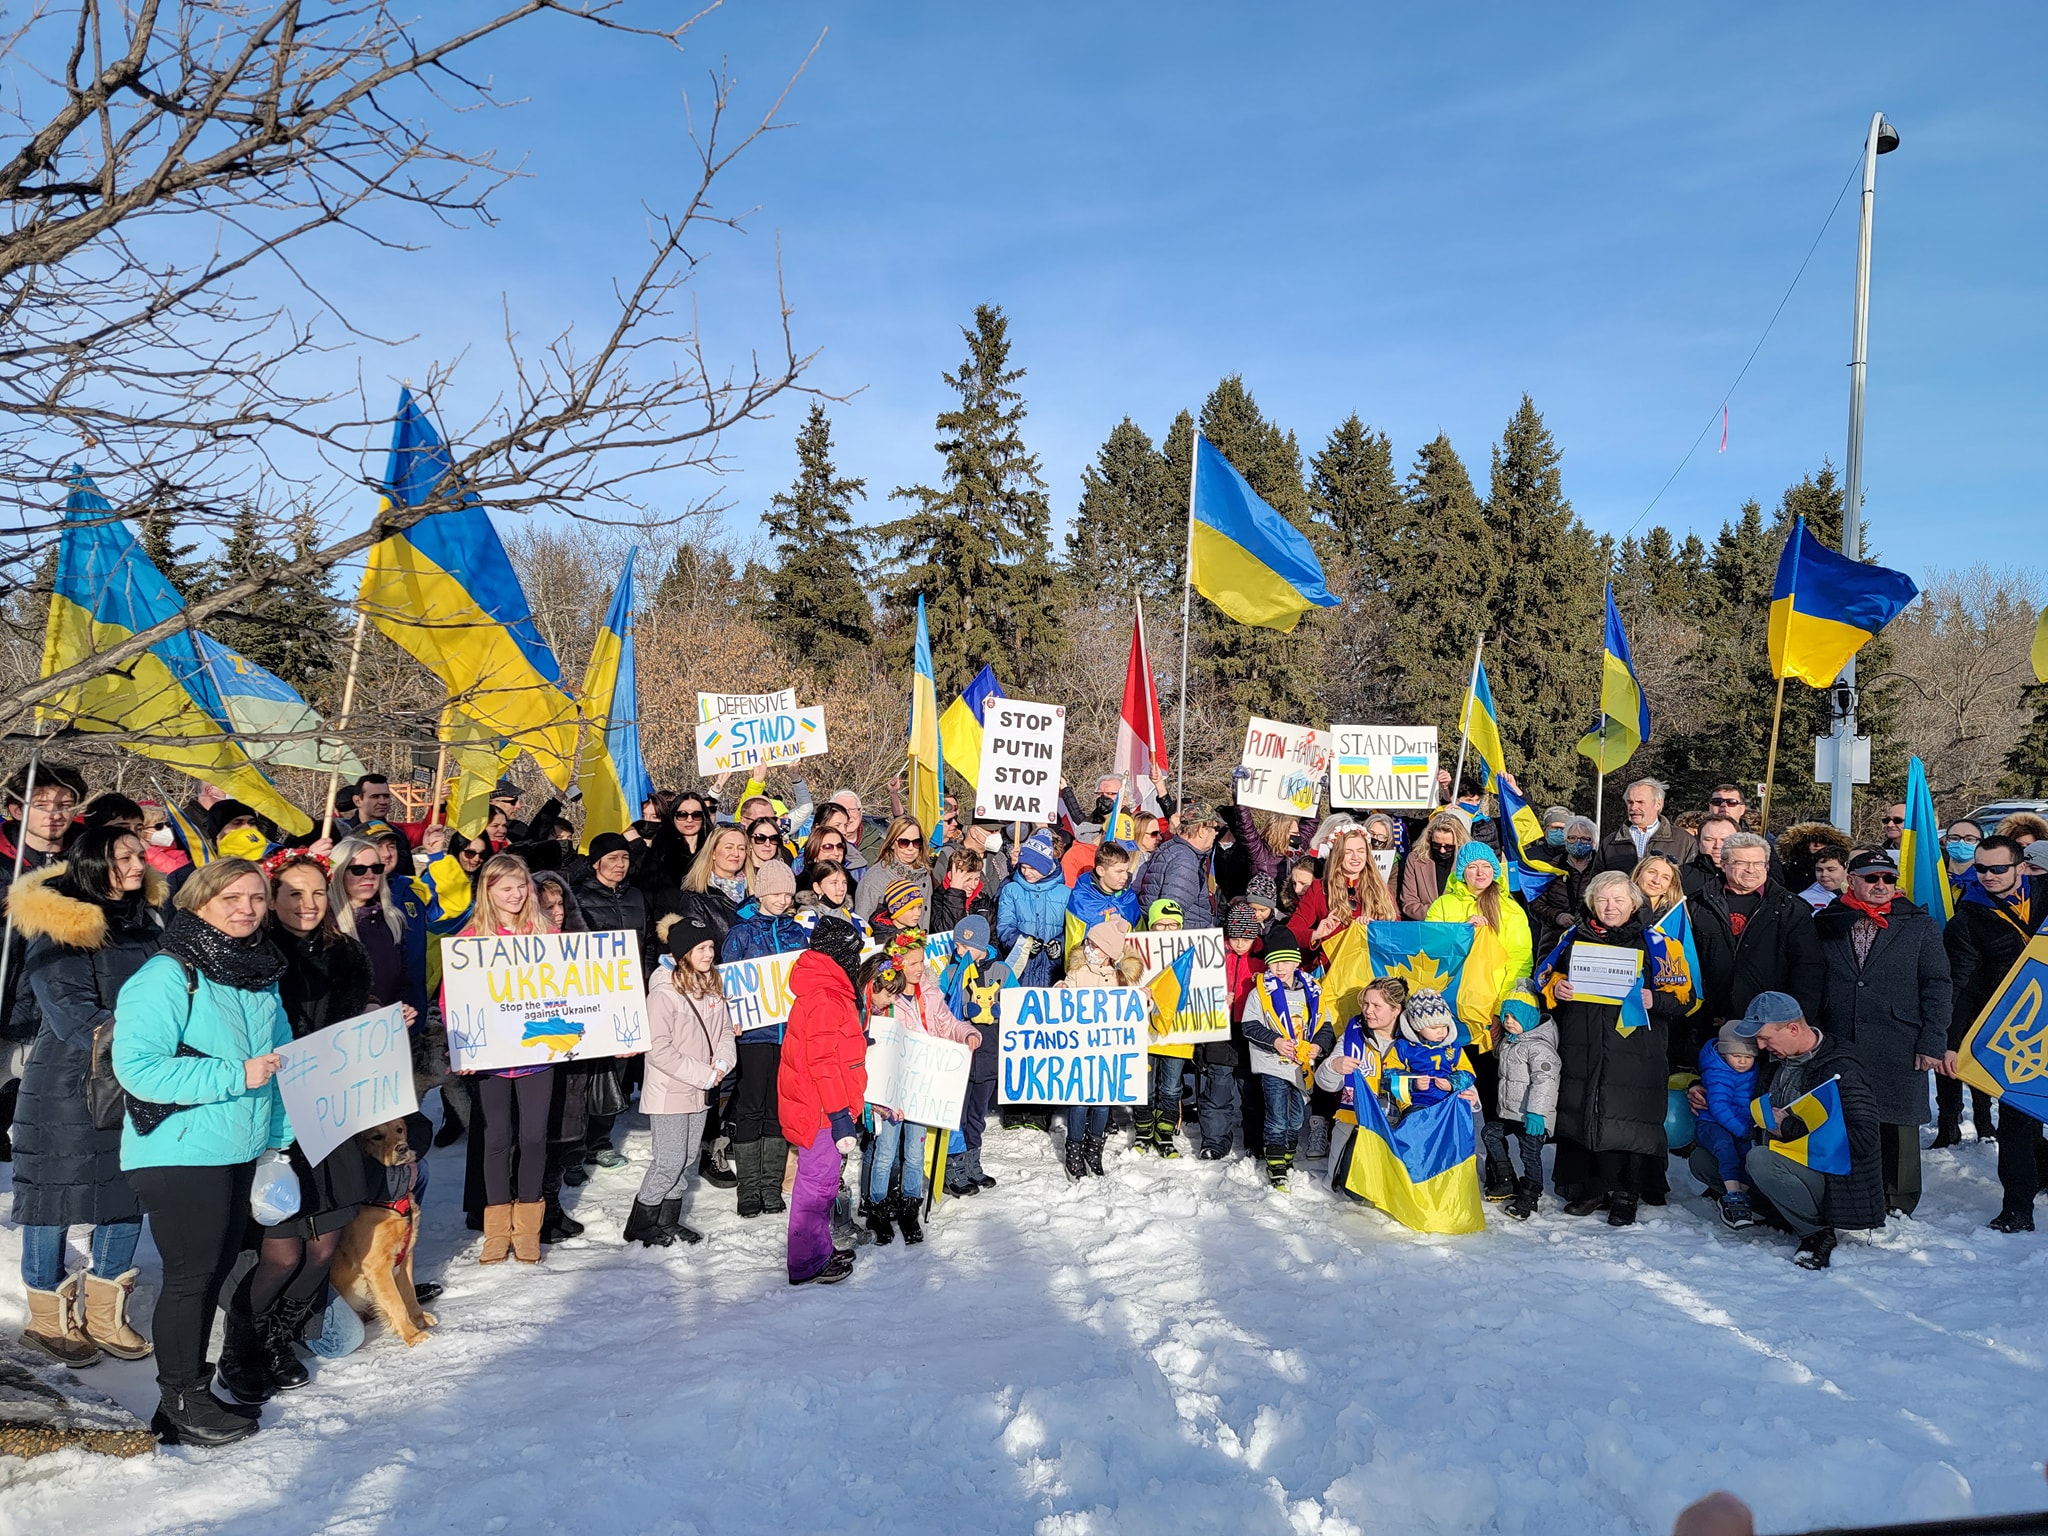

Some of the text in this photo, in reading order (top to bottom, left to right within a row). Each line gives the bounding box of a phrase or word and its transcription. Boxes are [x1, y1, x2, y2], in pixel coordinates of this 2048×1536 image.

[717, 692, 789, 715] DEFENSIVE
[730, 715, 795, 748] STAND
[1000, 711, 1052, 731] STOP
[715, 741, 806, 769] WITH UKRAINE
[993, 738, 1053, 760] PUTIN
[1340, 733, 1437, 755] STAND WITH
[995, 767, 1048, 786] STOP
[1339, 774, 1429, 800] UKRAINE
[994, 794, 1041, 813] WAR
[450, 932, 626, 970] STAND WITH
[487, 959, 634, 1003] UKRAINE
[718, 961, 760, 998] AND
[1608, 968, 1634, 977] UKRAINE
[500, 1003, 523, 1013] Stop
[525, 1001, 541, 1011] the
[524, 1004, 601, 1020] against Ukraine!
[725, 995, 762, 1028] ITH
[1016, 989, 1145, 1025] ALBERTA
[1003, 1027, 1136, 1052] STANDS WITH
[1430, 1055, 1442, 1070] 7
[1005, 1053, 1140, 1103] UKRAINE
[316, 1070, 401, 1137] PUTIN
